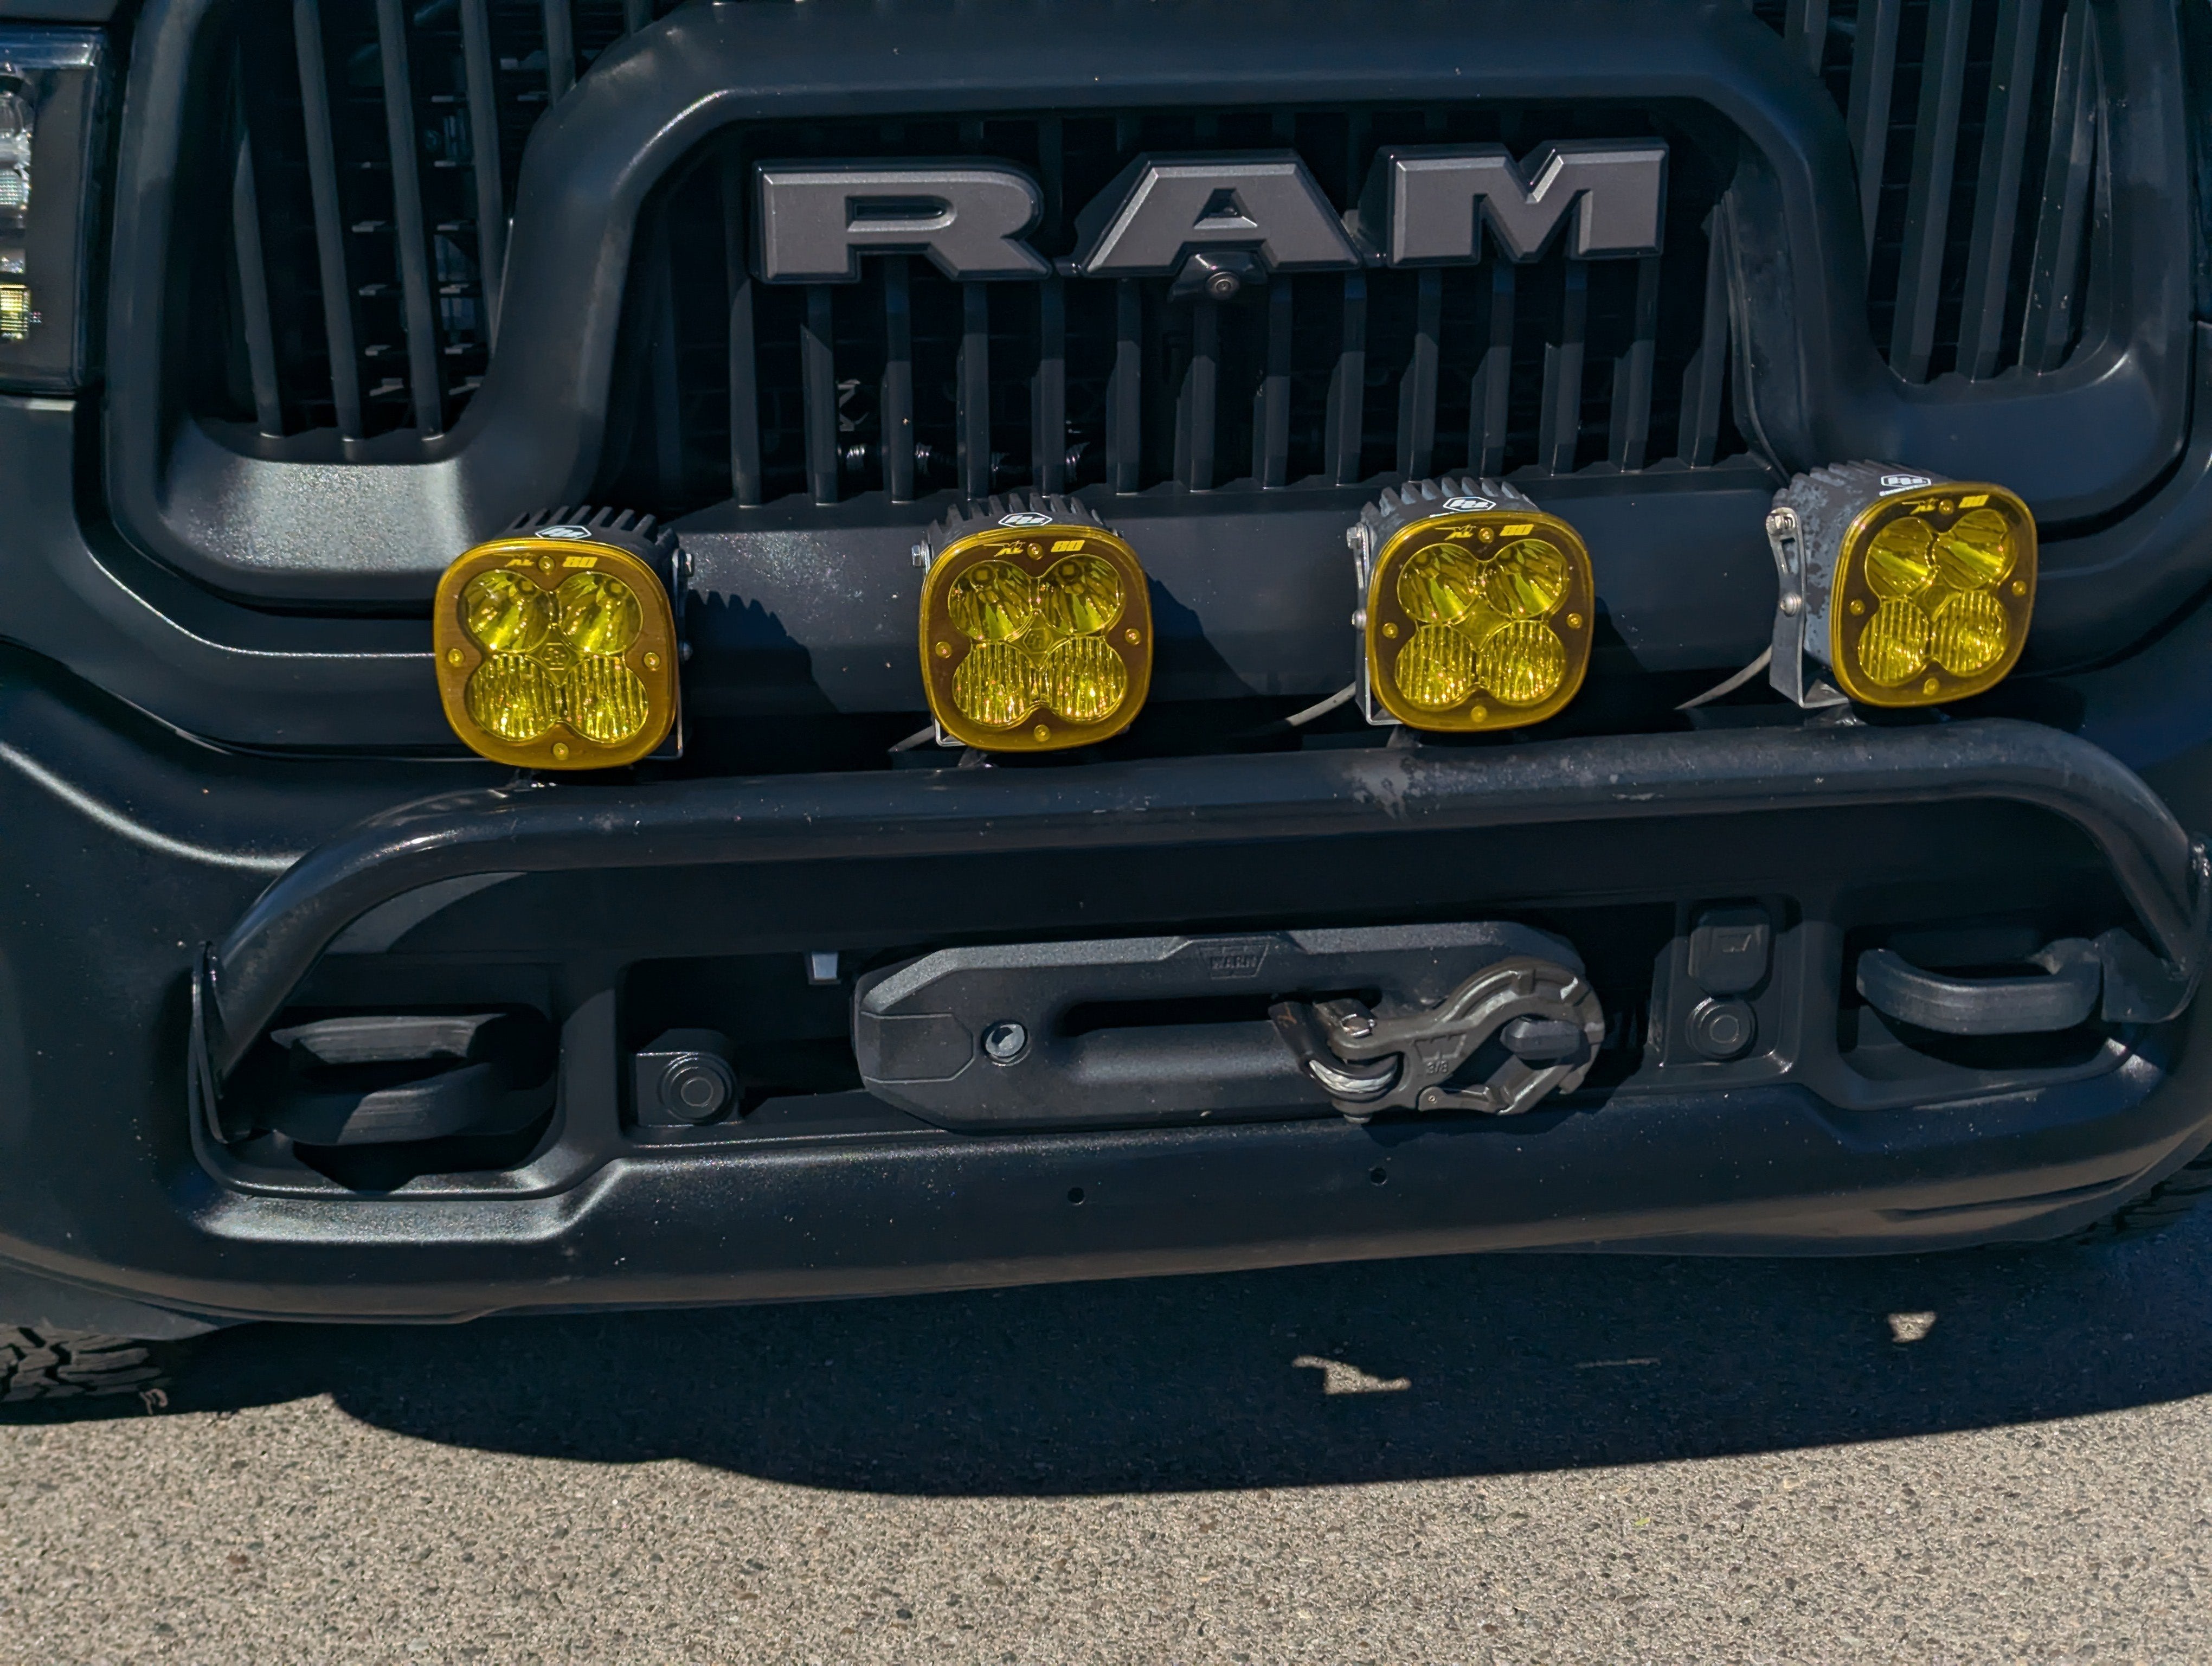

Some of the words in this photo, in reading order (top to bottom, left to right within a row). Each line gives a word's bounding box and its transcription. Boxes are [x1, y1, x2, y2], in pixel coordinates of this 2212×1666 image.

[753, 140, 1669, 282] RAM
[1499, 524, 1534, 536] 80
[1050, 540, 1085, 553] 80
[562, 556, 598, 568] 80
